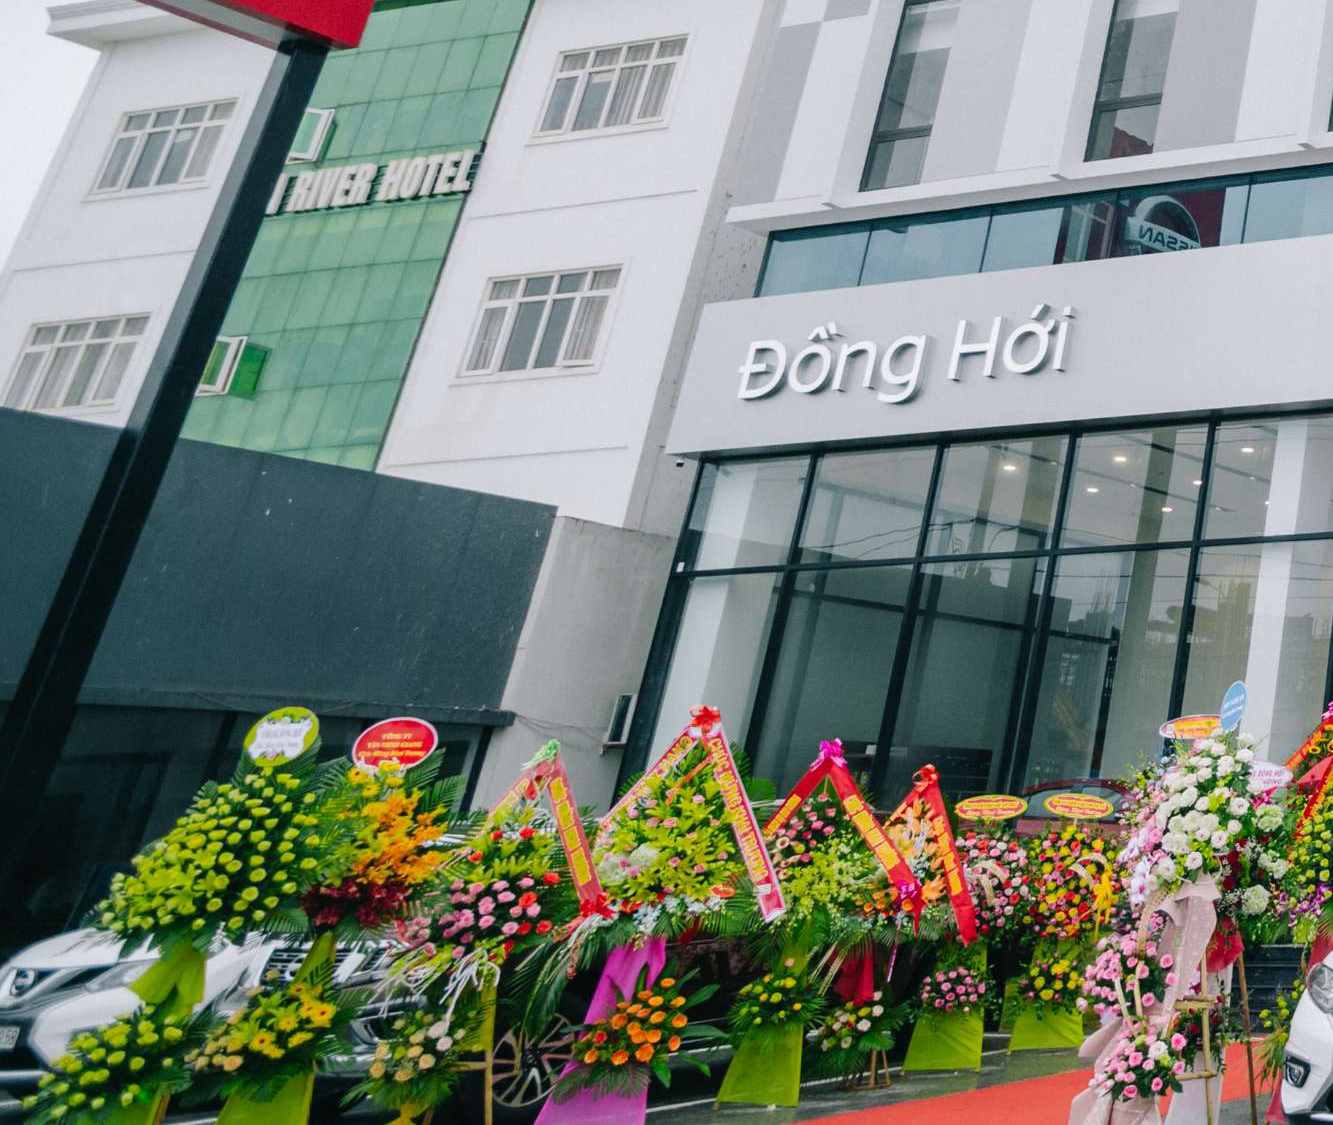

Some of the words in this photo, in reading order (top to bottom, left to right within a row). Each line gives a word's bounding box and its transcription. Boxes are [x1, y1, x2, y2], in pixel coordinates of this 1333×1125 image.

[286, 163, 377, 213] RIVER
[375, 149, 475, 201] HOTEL
[738, 321, 927, 404] Đồng
[948, 303, 1076, 381] Hới
